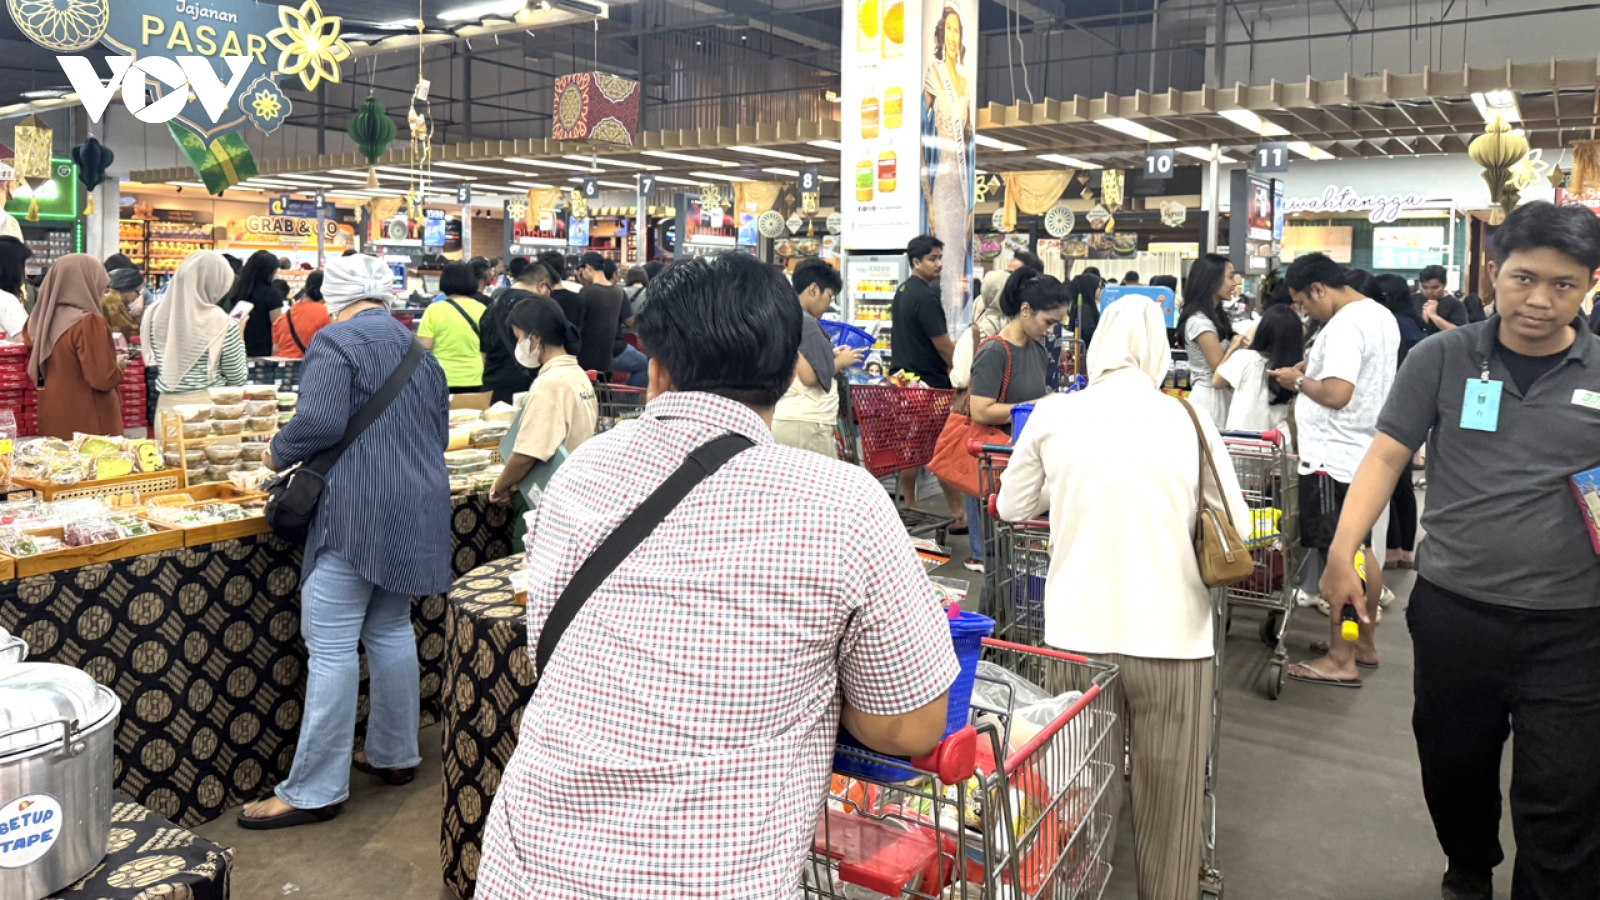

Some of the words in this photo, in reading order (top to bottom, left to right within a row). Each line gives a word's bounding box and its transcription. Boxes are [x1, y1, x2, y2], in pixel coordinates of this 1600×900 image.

[176, 0, 238, 23] Jajanan
[142, 14, 267, 65] PASAR
[1146, 155, 1171, 173] 10
[1258, 149, 1282, 167] 11
[586, 181, 595, 196] 6
[642, 179, 652, 193] 7
[803, 173, 813, 188] 8
[282, 196, 287, 208] 1
[316, 195, 322, 207] 2
[459, 188, 467, 201] 5
[247, 217, 295, 233] GRAB
[299, 219, 311, 234] &
[315, 221, 338, 235] O
[0, 828, 54, 853] TAPE
